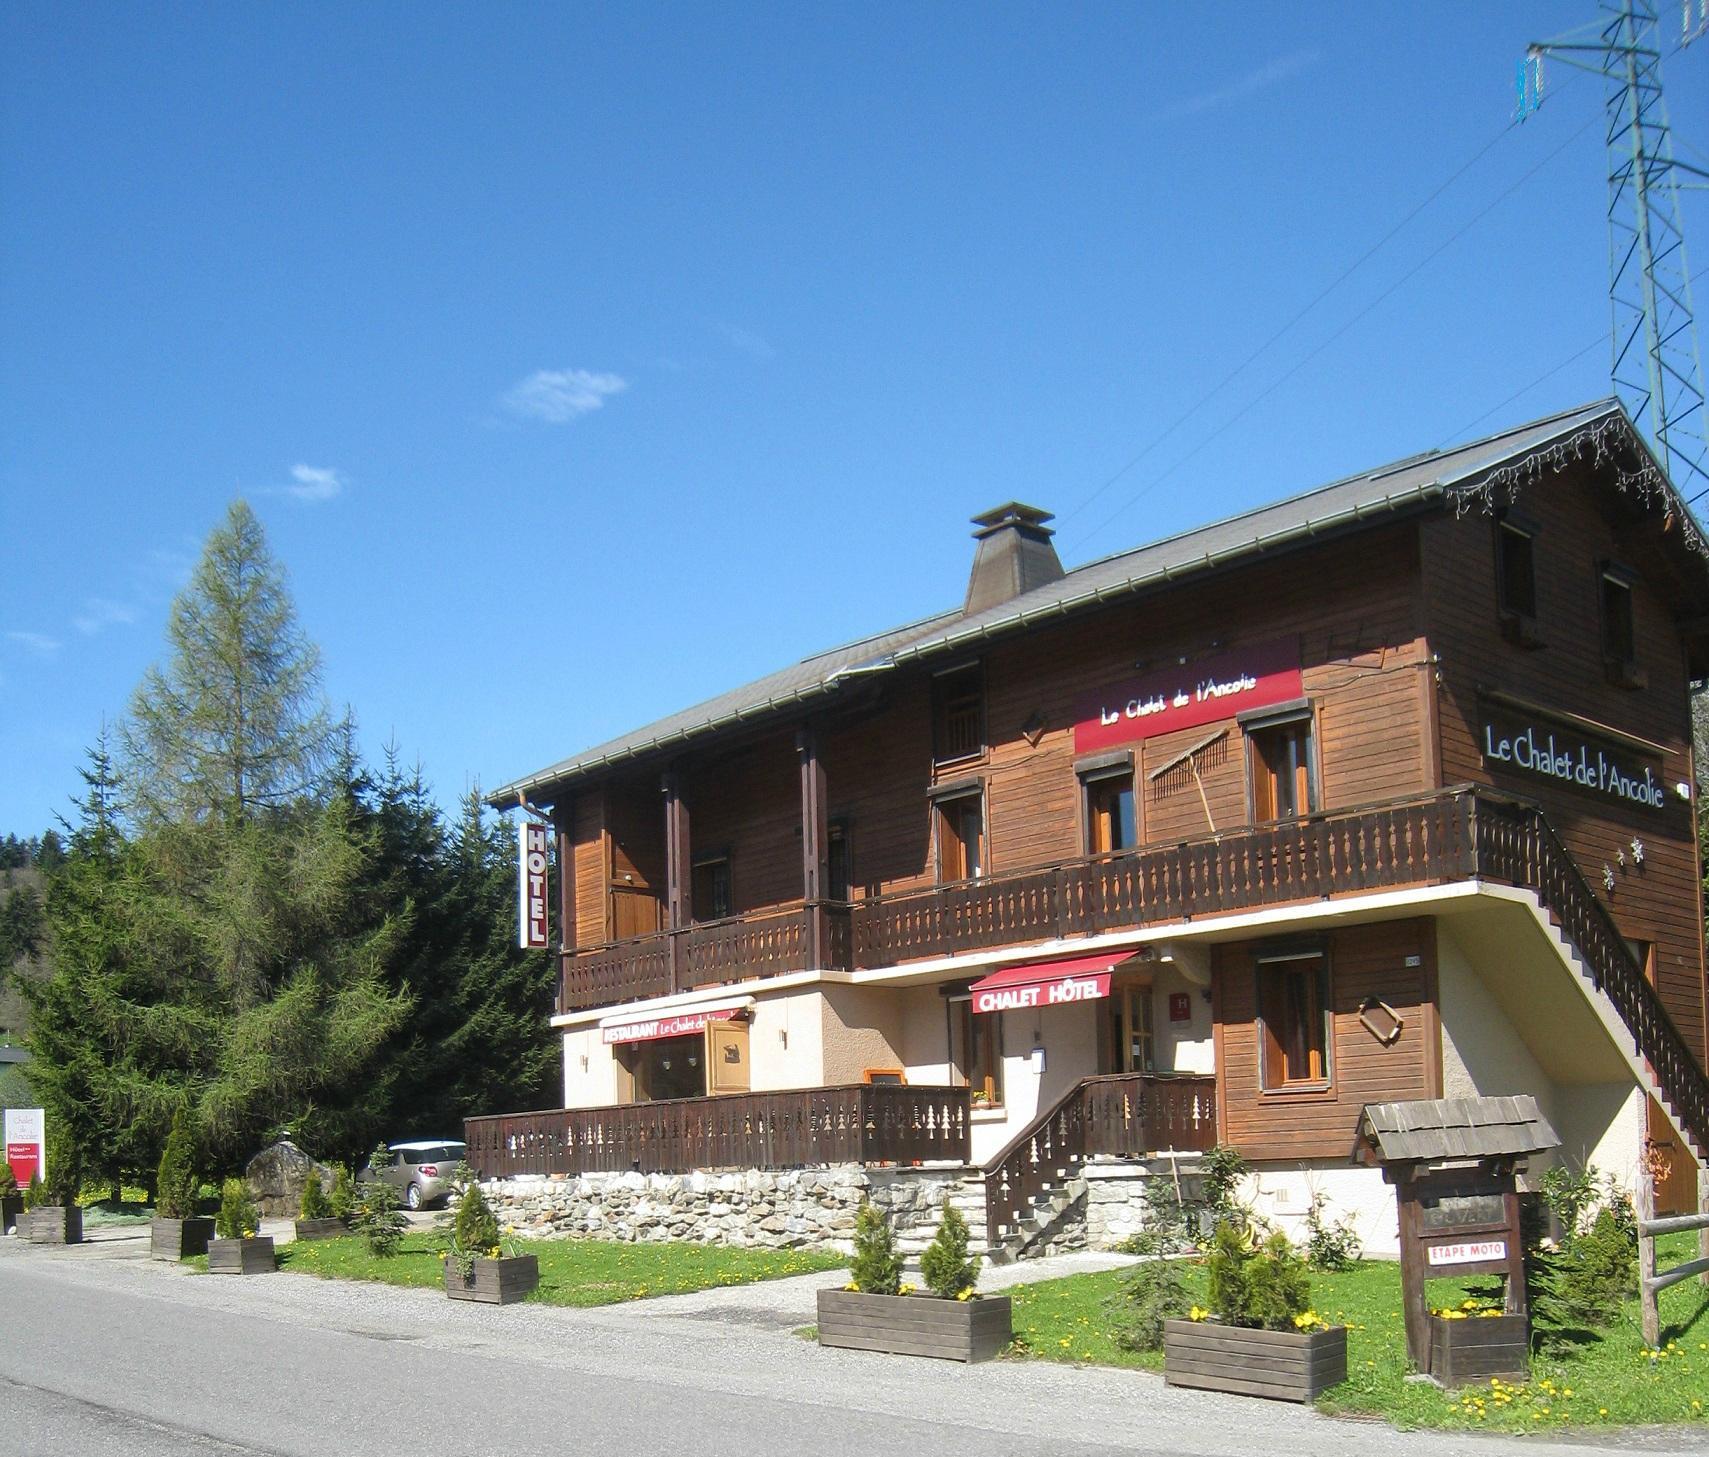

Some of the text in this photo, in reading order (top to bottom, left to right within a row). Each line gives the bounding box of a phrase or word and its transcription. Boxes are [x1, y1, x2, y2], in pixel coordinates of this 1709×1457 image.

[1101, 707, 1120, 726] Le
[1126, 694, 1167, 719] Chalet
[1173, 689, 1190, 708] de
[1485, 725, 1665, 808] Le Chalet de l'Ancolie
[528, 829, 546, 942] HOTEL
[979, 979, 1103, 1012] CHALET HÔTEL
[604, 1021, 661, 1043] RESTAURANT
[660, 1023, 670, 1035] Le
[670, 1018, 696, 1034] Chalet
[1432, 1243, 1501, 1259] ETAPE MOTO
